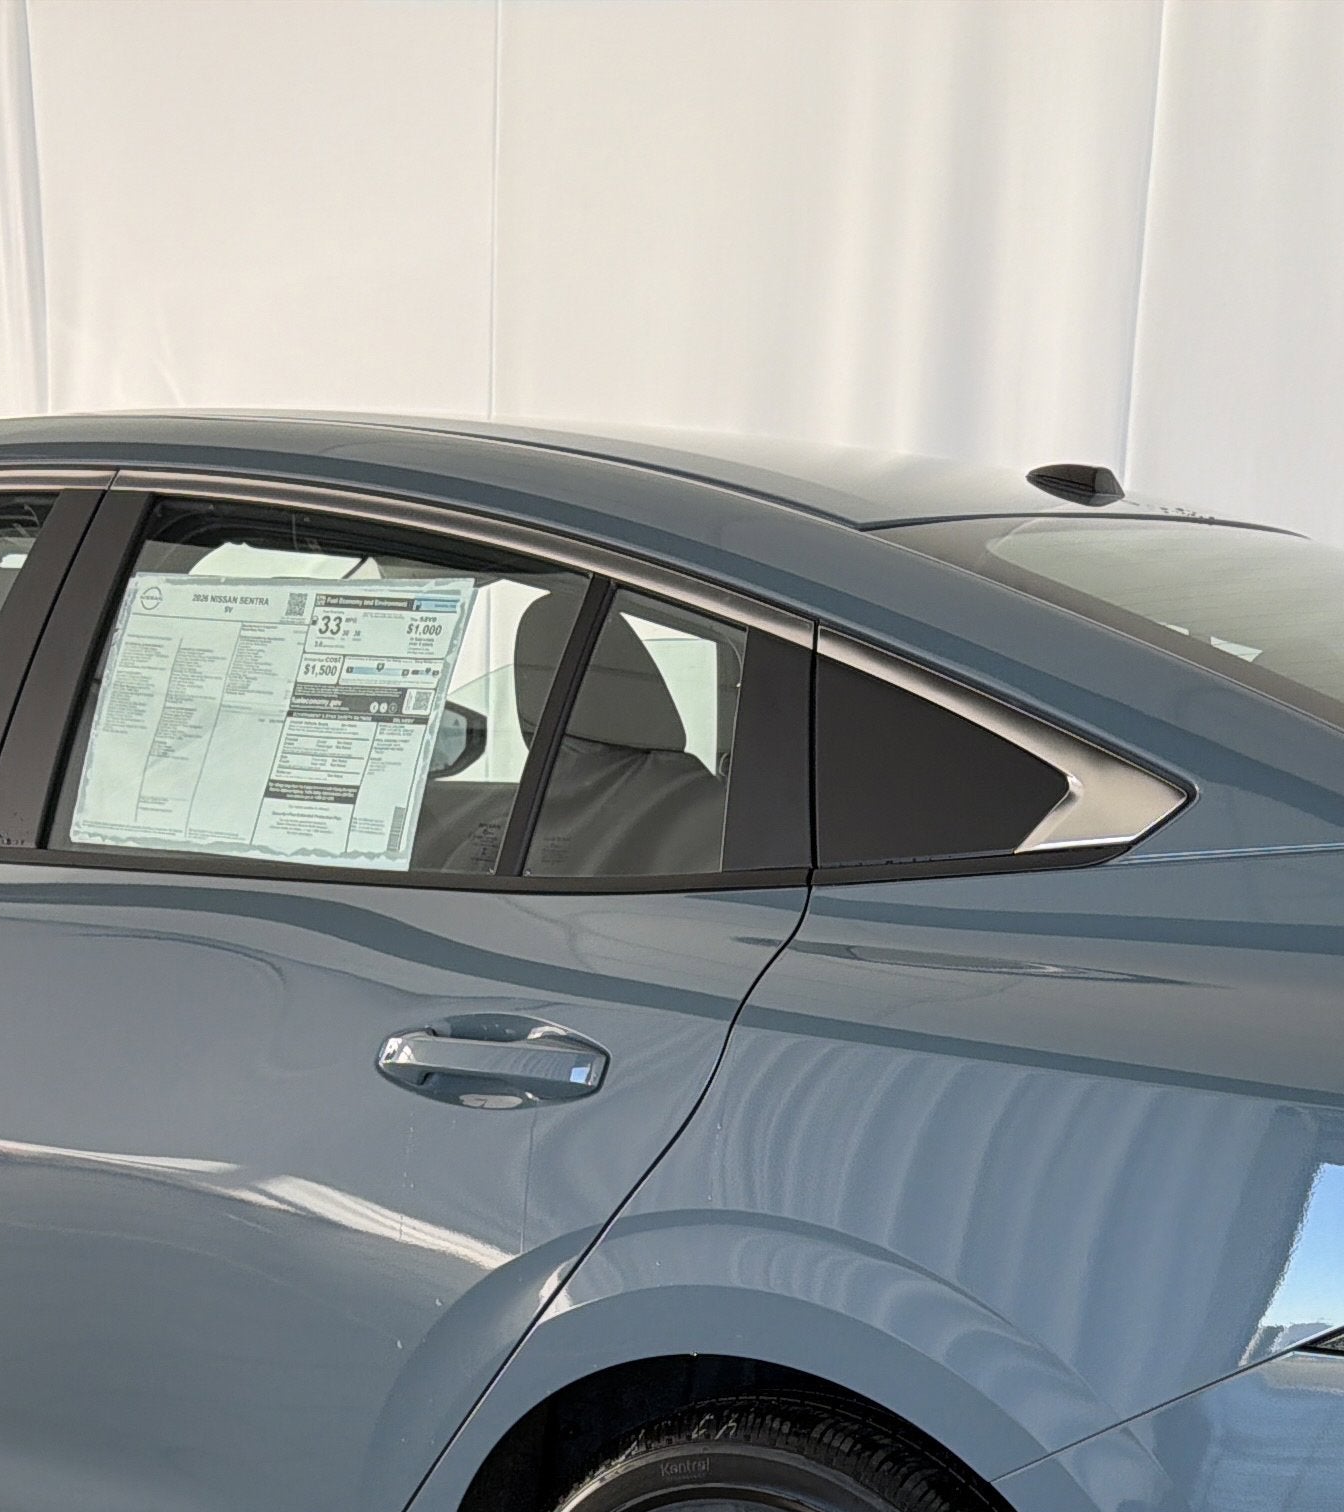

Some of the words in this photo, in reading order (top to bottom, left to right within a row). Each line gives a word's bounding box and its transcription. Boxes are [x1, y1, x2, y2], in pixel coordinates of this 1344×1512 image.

[210, 594, 238, 605] NISSAN
[239, 595, 269, 606] SENTRA
[326, 596, 339, 605] Fuel
[339, 597, 363, 606] Economy
[363, 598, 374, 606] and
[224, 606, 234, 614] SV
[318, 615, 343, 636] 33
[407, 623, 443, 637] $1,000
[303, 663, 338, 678] $1,500
